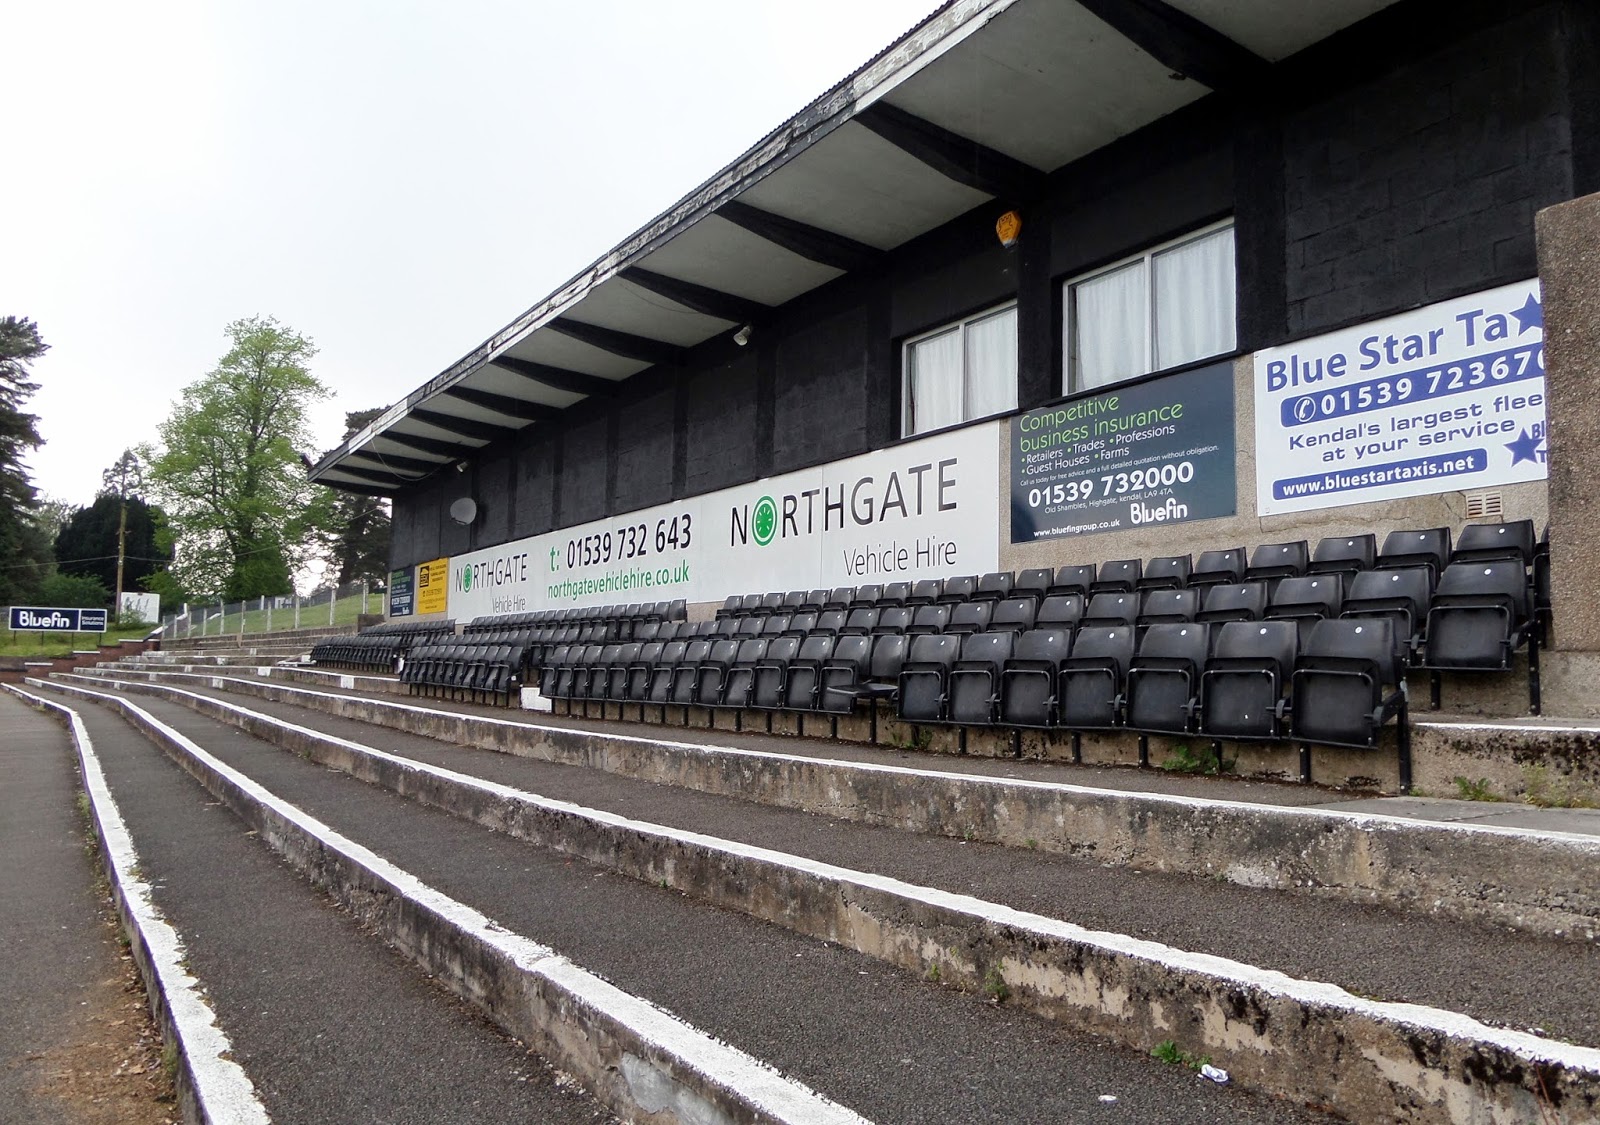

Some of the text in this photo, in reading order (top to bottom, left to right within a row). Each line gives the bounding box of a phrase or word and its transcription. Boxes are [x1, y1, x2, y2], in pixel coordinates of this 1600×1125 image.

[1266, 353, 1347, 392] Blue
[1359, 327, 1443, 371] Star
[1020, 396, 1119, 433] Competitive
[1321, 378, 1413, 411] 01539
[1020, 403, 1183, 452] business insurance
[1289, 393, 1543, 450] Kendal's largest flee
[1322, 419, 1515, 462] at your service
[1026, 424, 1175, 464] Retailers Trades Professions
[1026, 446, 1130, 476] Guest Houses Farms
[1111, 460, 1132, 470] detailed
[1133, 455, 1160, 466] quotation
[1161, 450, 1185, 460] without
[1028, 462, 1194, 508] 01539 732000
[1283, 455, 1475, 496] www.bluestartaxis.net
[731, 457, 958, 547] NORTHGATE
[1044, 505, 1056, 514] Old
[1144, 490, 1158, 498] LA9
[1130, 498, 1188, 525] Bluefin
[550, 513, 692, 572] t: 01539 732 643
[1033, 519, 1120, 538] www.bluefingroup.co.uk
[455, 553, 528, 593] NORTHGATE
[843, 535, 957, 576] Vehicle Hire
[548, 560, 690, 601] northgatevehiclehire.co.uk
[19, 610, 70, 628] Bluefin
[492, 595, 526, 614] Vehicle Hire
